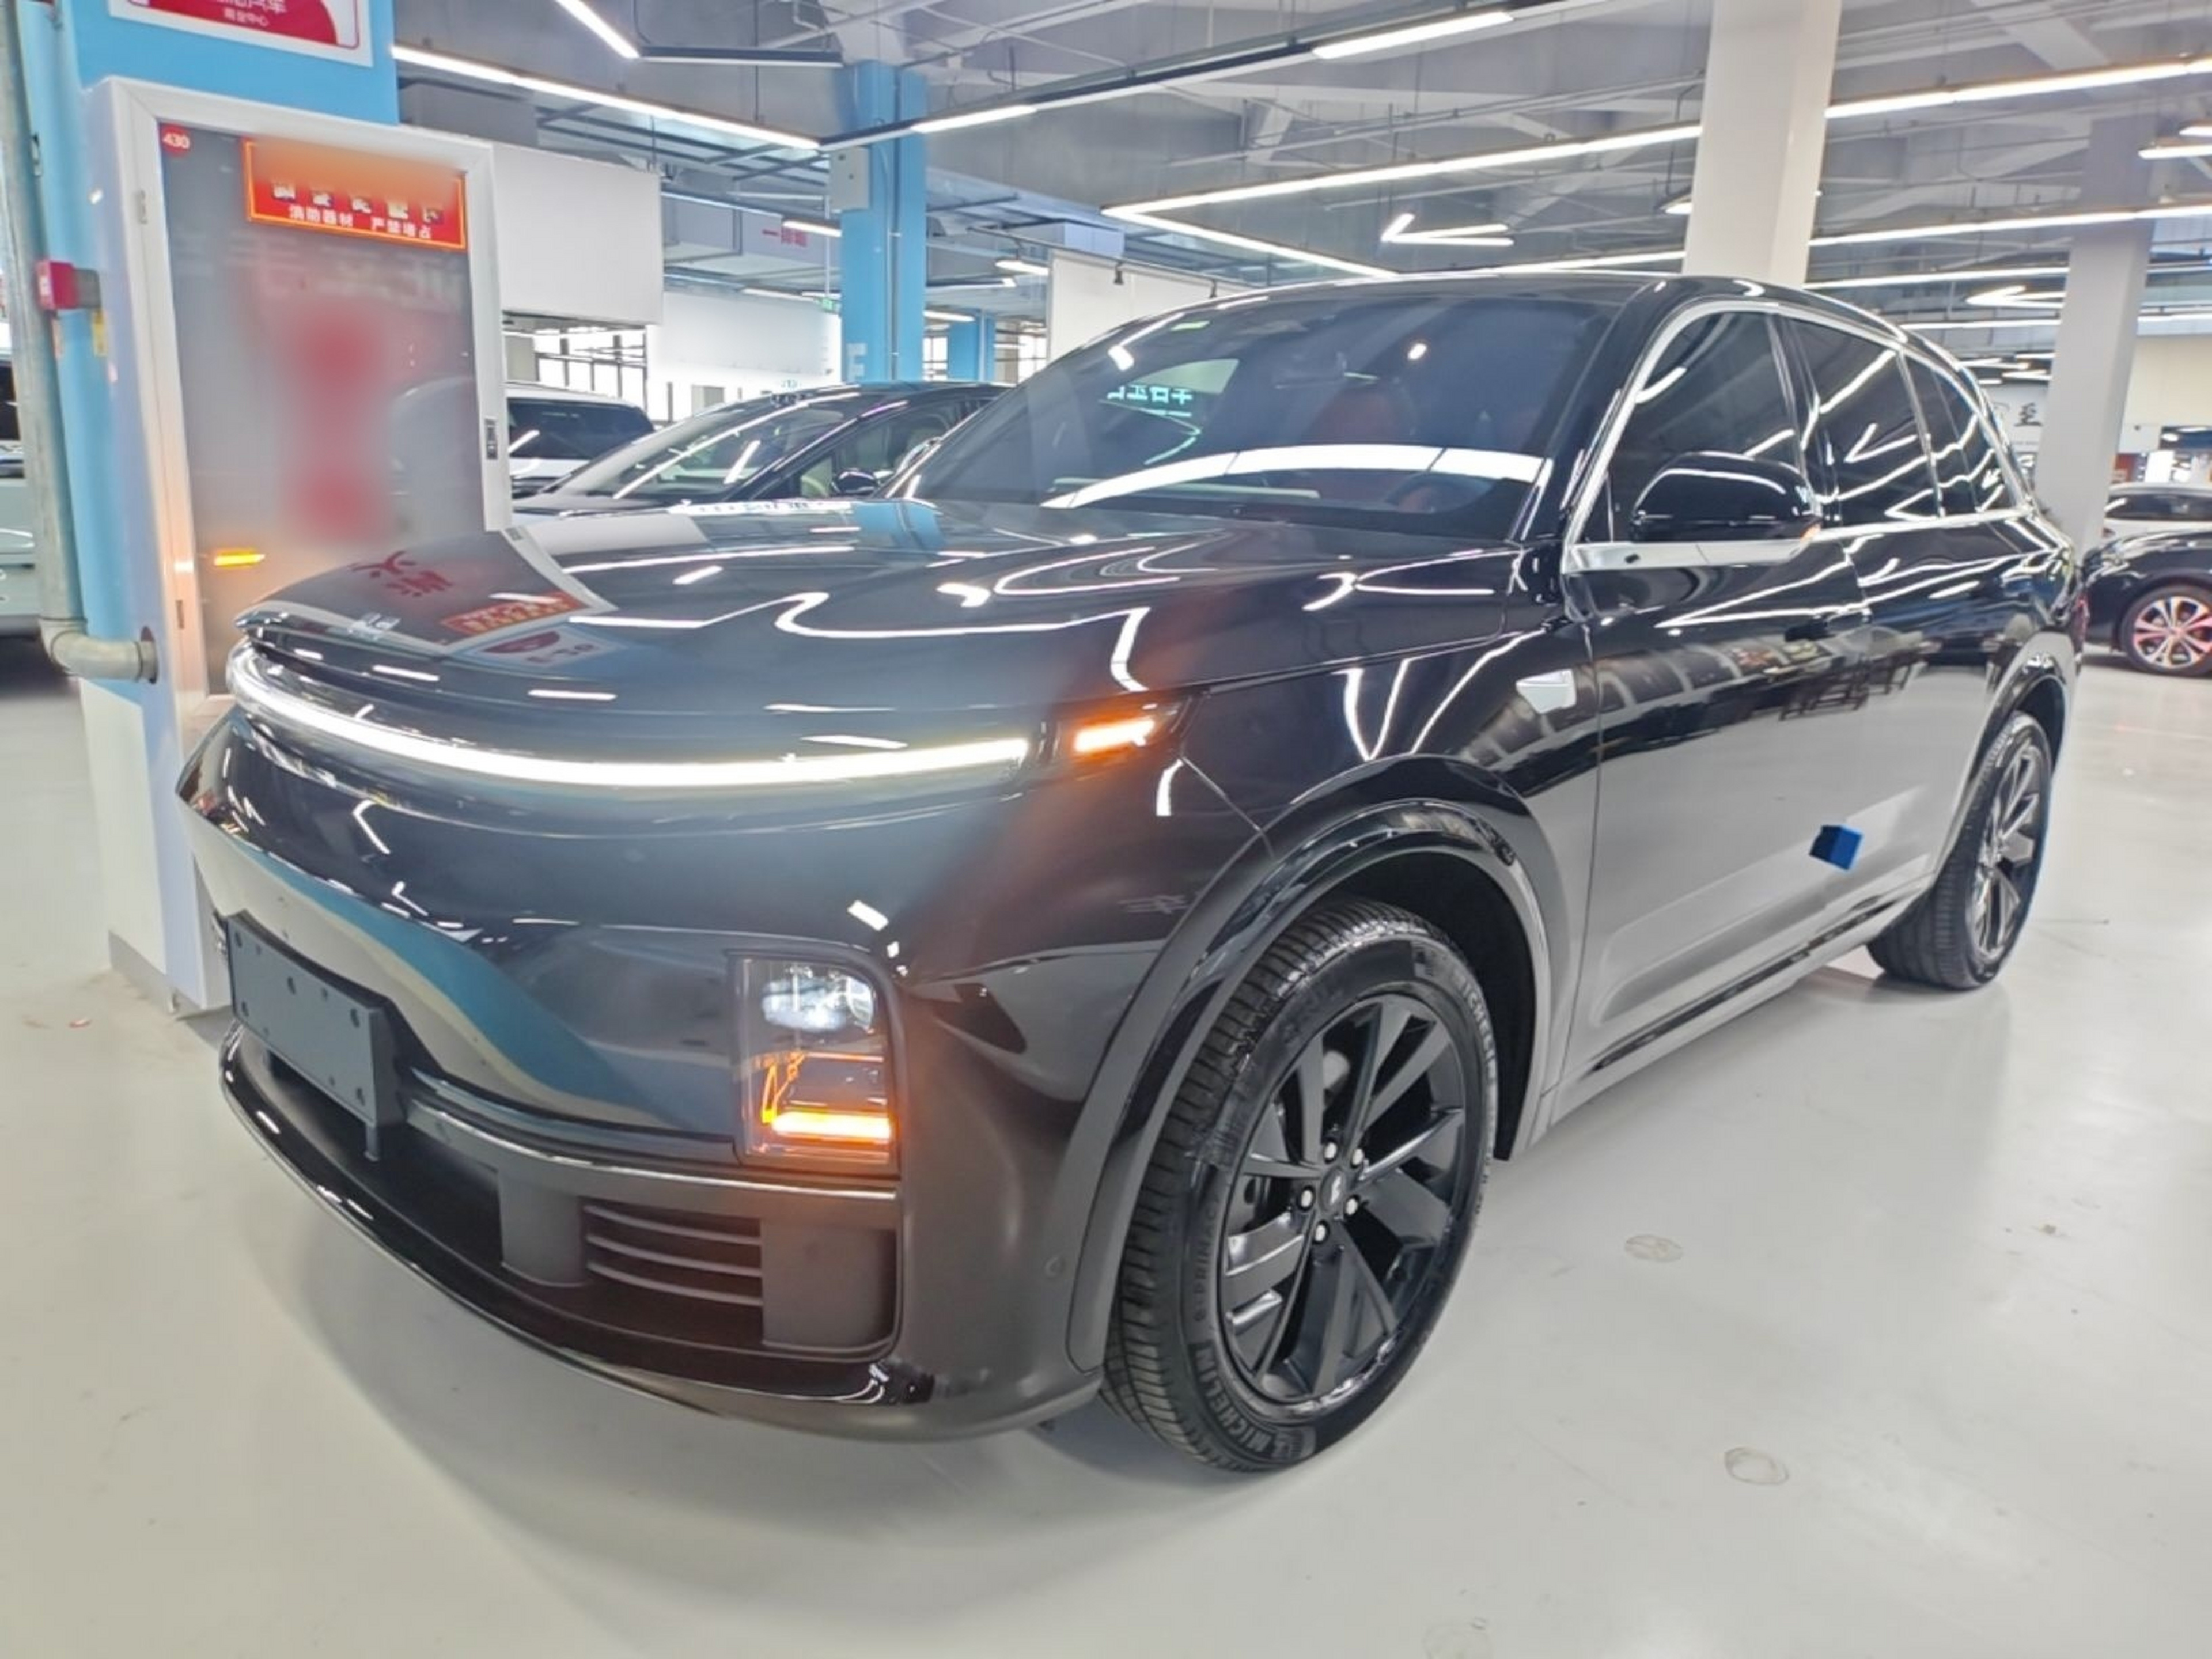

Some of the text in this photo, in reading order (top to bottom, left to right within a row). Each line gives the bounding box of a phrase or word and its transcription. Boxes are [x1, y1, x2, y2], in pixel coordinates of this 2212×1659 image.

[163, 132, 190, 149] 430
[1452, 969, 1497, 1078] MICHELIN
[1195, 1347, 1272, 1452] MICHELIN
